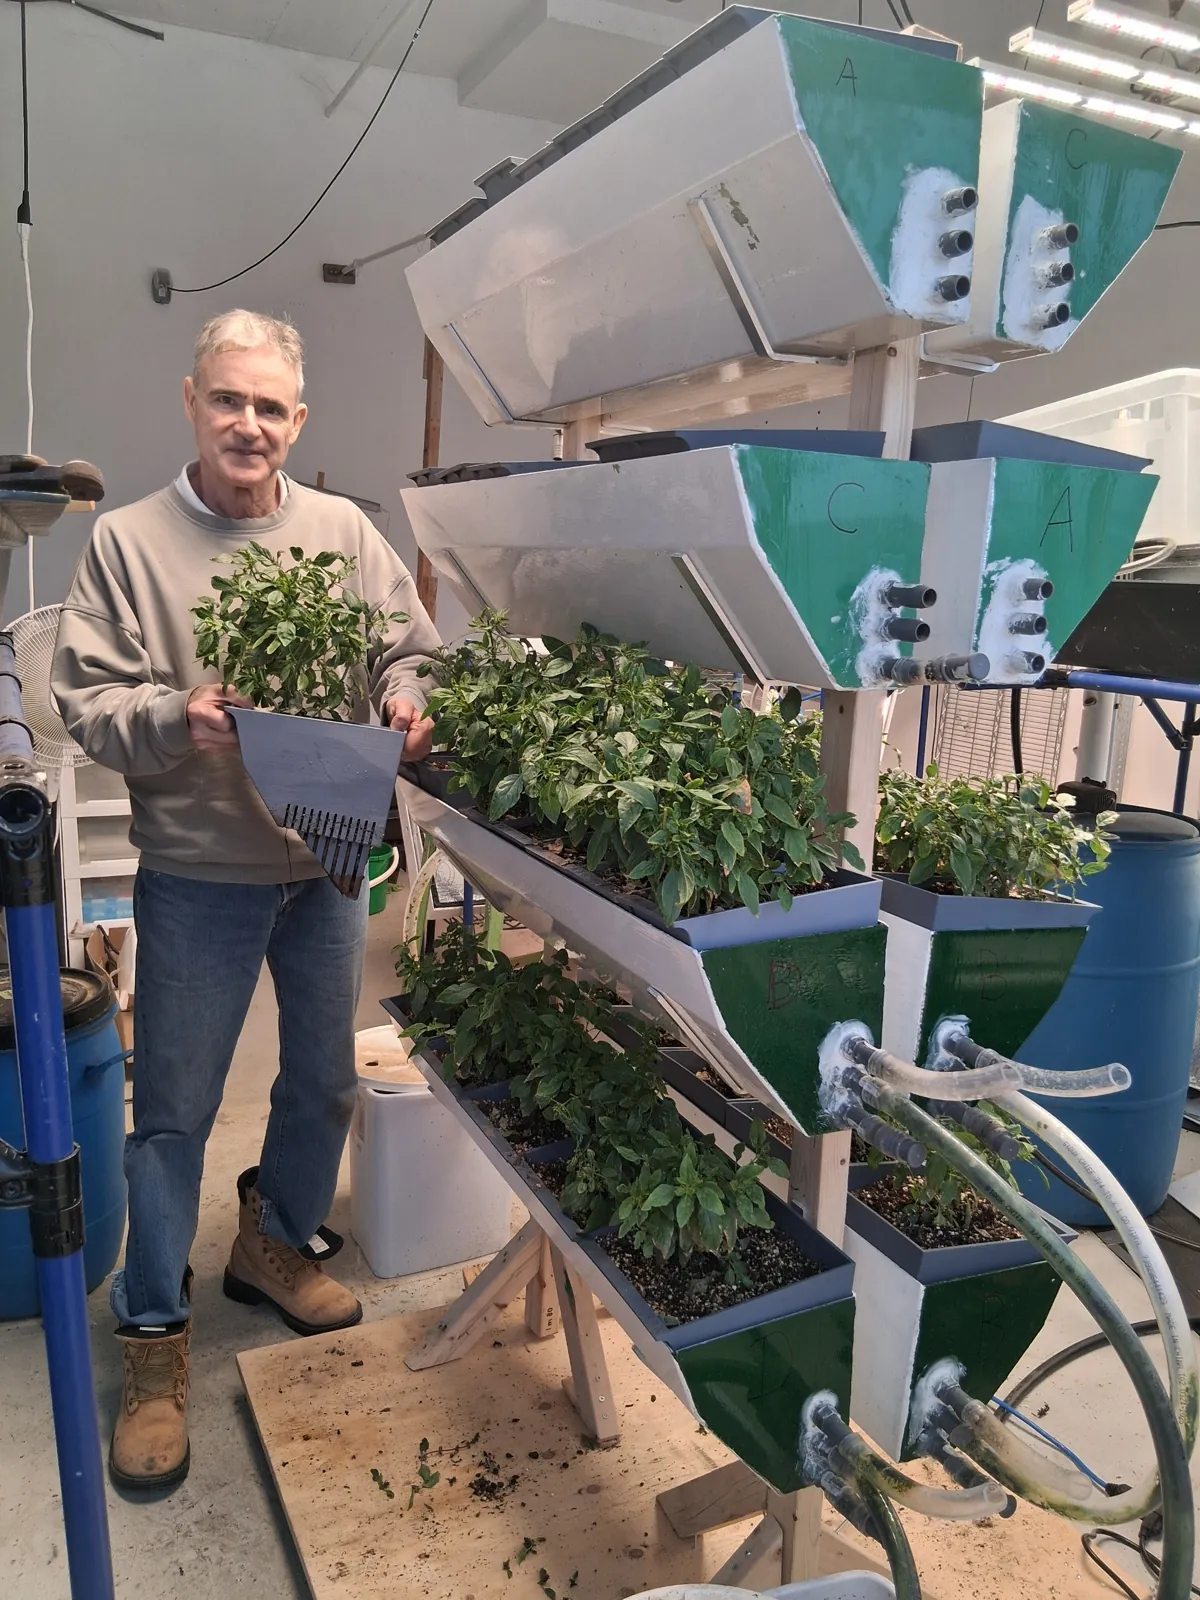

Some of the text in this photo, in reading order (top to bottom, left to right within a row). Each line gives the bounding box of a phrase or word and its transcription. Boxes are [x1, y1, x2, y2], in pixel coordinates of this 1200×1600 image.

[836, 57, 858, 97] A
[1065, 128, 1088, 170] C
[828, 482, 866, 534] C
[1039, 486, 1073, 552] A
[767, 959, 802, 1010] B
[1063, 1141, 1078, 1157] SIOUX
[1078, 1156, 1095, 1175] CHIEF
[1093, 1176, 1105, 1189] 3/4
[985, 1185, 1004, 1204] SIOUX
[1005, 1205, 1025, 1223] CHIEF
[1029, 1229, 1042, 1240] 3/4
[1165, 1312, 1176, 1330] MADE
[1171, 1335, 1179, 1344] IN
[748, 1330, 794, 1402] D
[1174, 1346, 1183, 1369] CHINA
